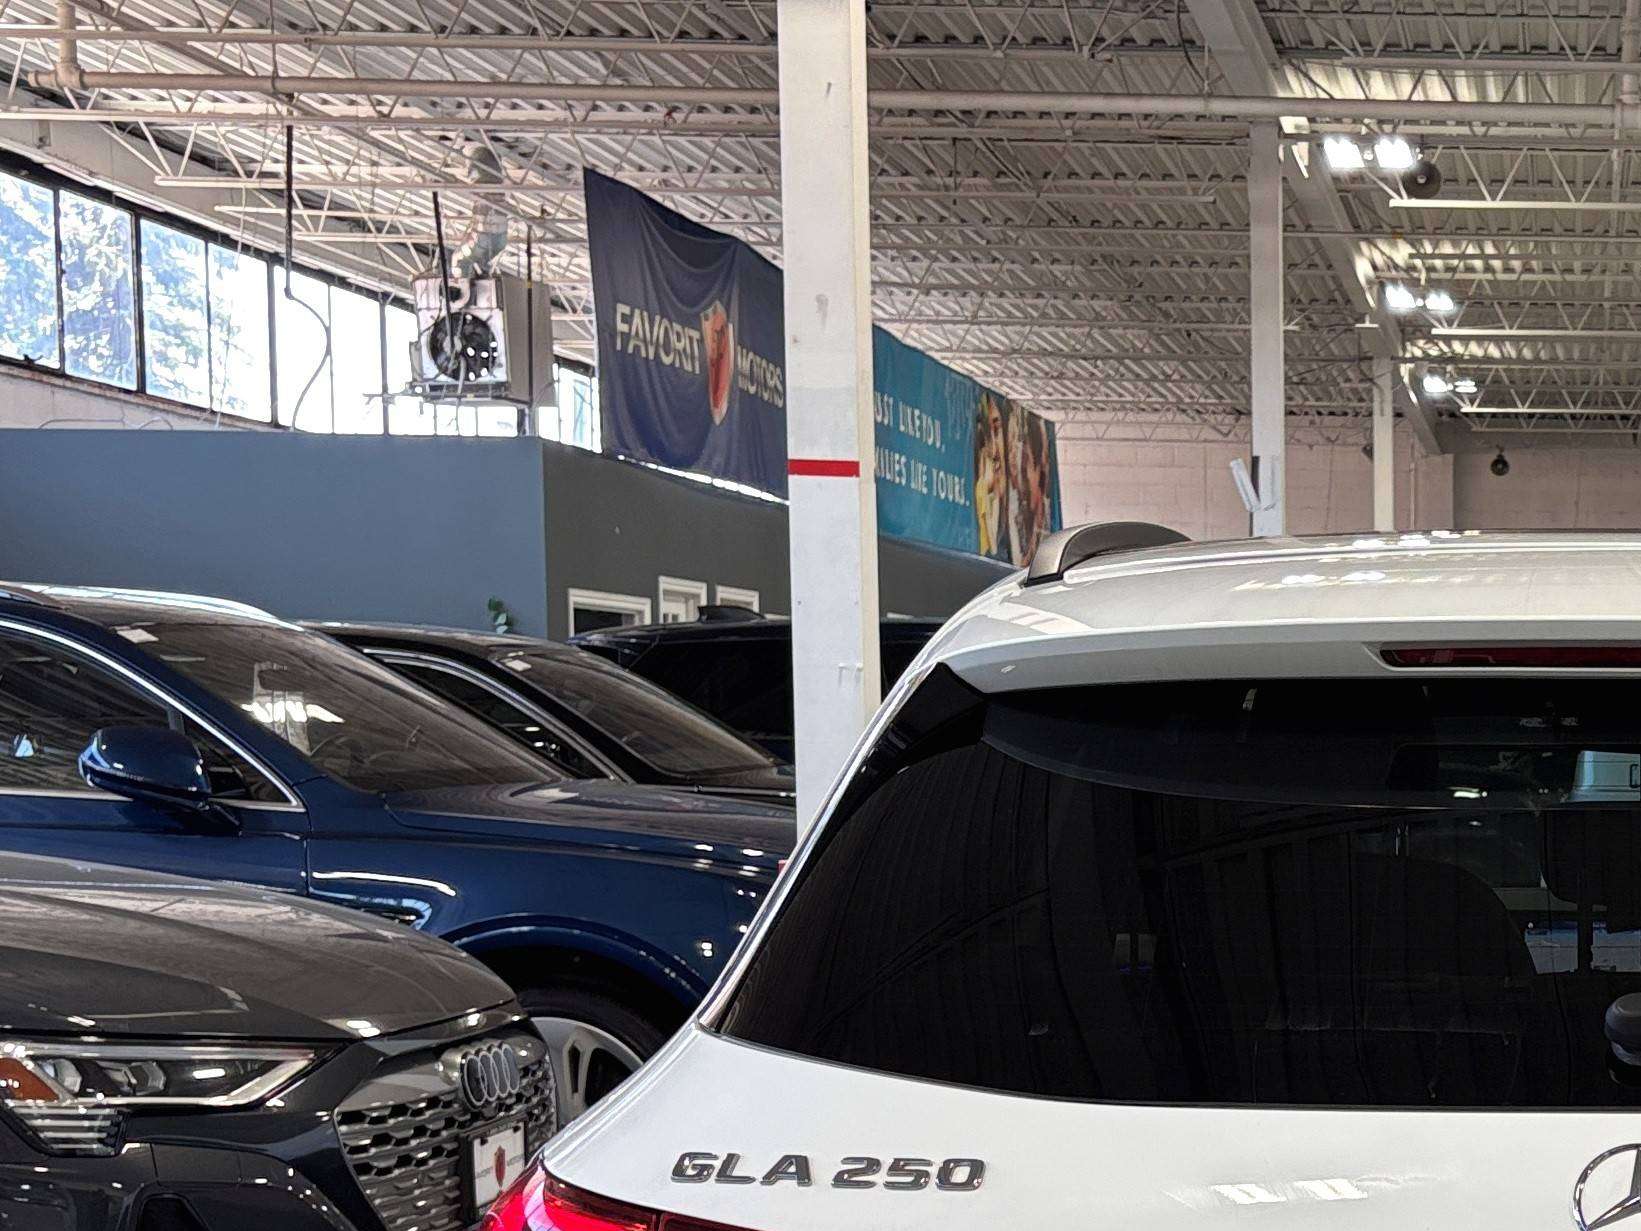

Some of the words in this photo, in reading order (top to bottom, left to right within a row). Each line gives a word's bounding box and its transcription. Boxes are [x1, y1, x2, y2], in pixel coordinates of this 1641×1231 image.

[615, 302, 701, 375] FAVORIT
[736, 345, 785, 409] MOTORS
[875, 391, 894, 427] UST
[670, 1151, 814, 1188] GLA
[830, 1156, 988, 1192] 250
